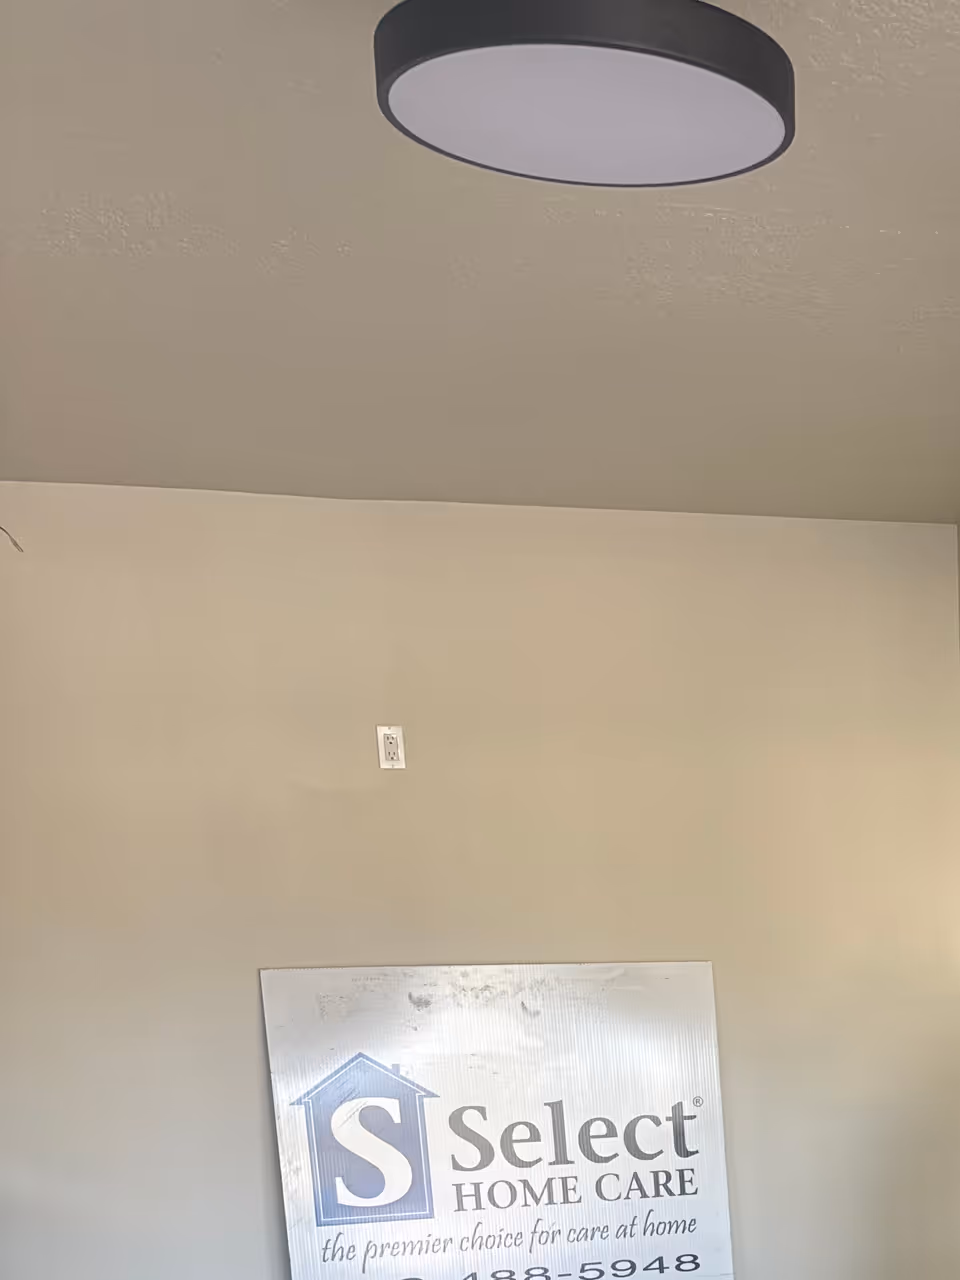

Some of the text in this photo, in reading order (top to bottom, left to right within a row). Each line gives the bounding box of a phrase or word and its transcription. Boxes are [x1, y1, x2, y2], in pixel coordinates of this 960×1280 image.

[331, 1097, 412, 1207] S
[448, 1100, 699, 1171] Select
[453, 1169, 698, 1210] HOME CARE
[322, 1209, 697, 1274] the premier choice for care at home
